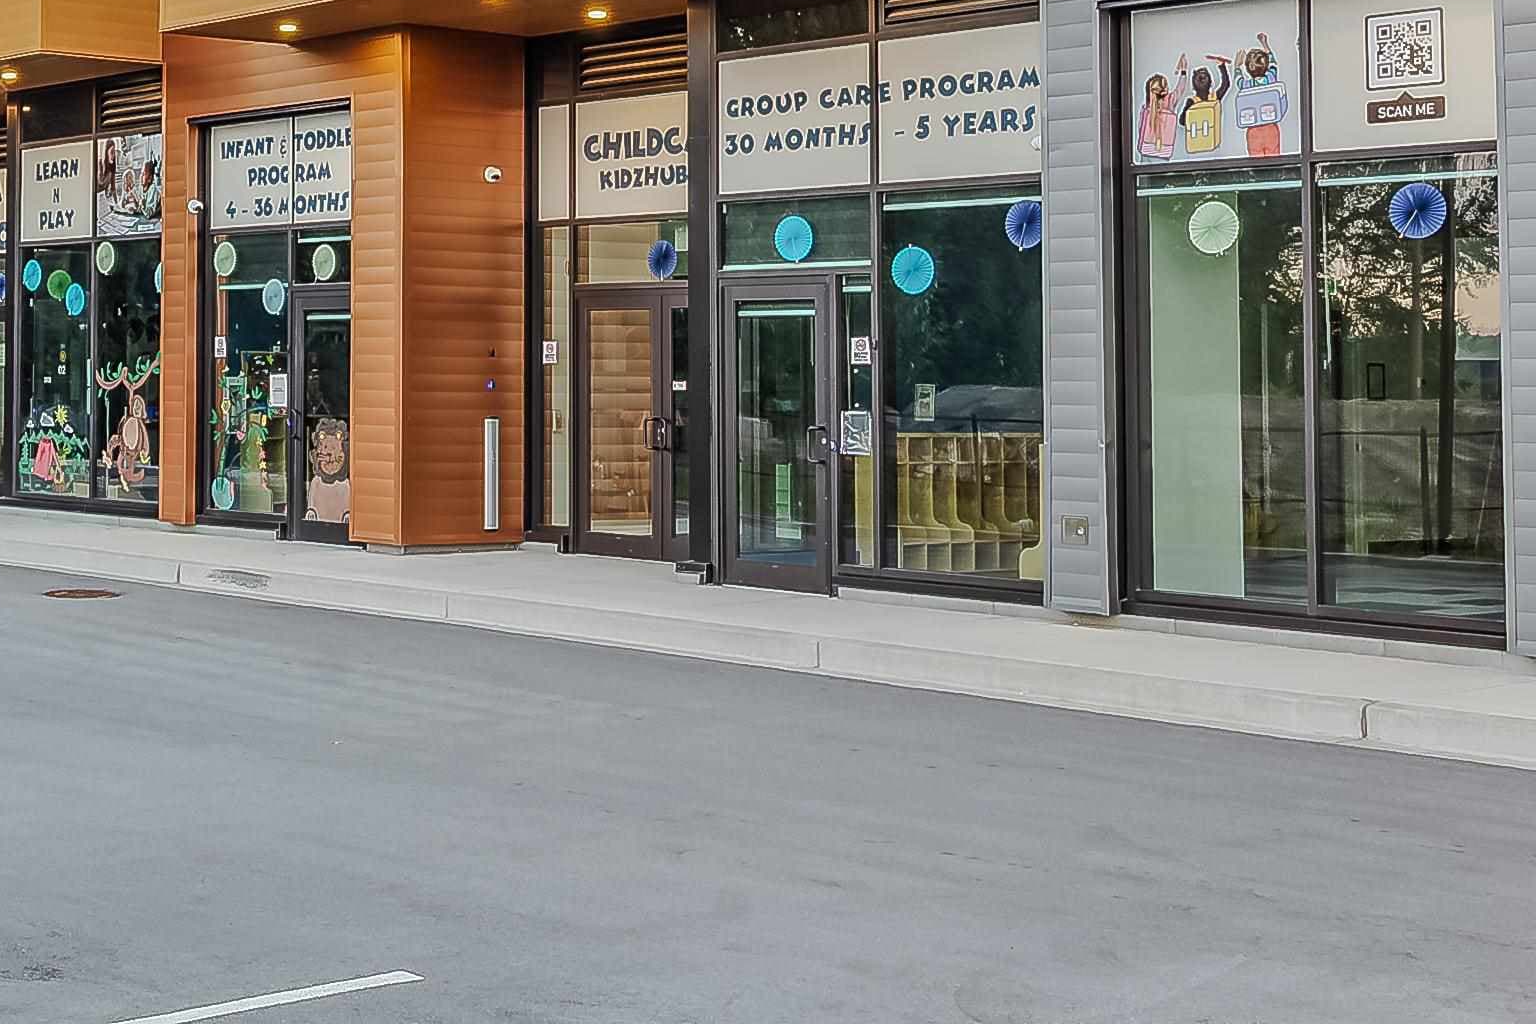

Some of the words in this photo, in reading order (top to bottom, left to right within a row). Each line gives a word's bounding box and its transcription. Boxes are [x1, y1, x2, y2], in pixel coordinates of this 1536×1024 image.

[726, 91, 808, 118] GROUP
[819, 81, 891, 109] CARE
[902, 66, 1040, 101] PROGRAM
[1378, 104, 1413, 119] SCAN
[1416, 102, 1436, 116] ME
[725, 134, 754, 155] 30
[764, 122, 872, 152] MONTHS
[915, 115, 930, 139] 5
[943, 105, 1036, 137] YEARS
[220, 136, 274, 159] INFANT
[279, 136, 287, 158] &
[583, 127, 688, 161] CHILDC
[36, 159, 79, 181] LEARN
[247, 161, 332, 187] PROGRAM
[599, 164, 688, 190] KIDZHUB
[52, 188, 60, 204] N
[226, 201, 237, 219] 4
[254, 197, 273, 217] 36
[278, 191, 350, 215] MONTHS
[39, 209, 75, 230] PLAY
